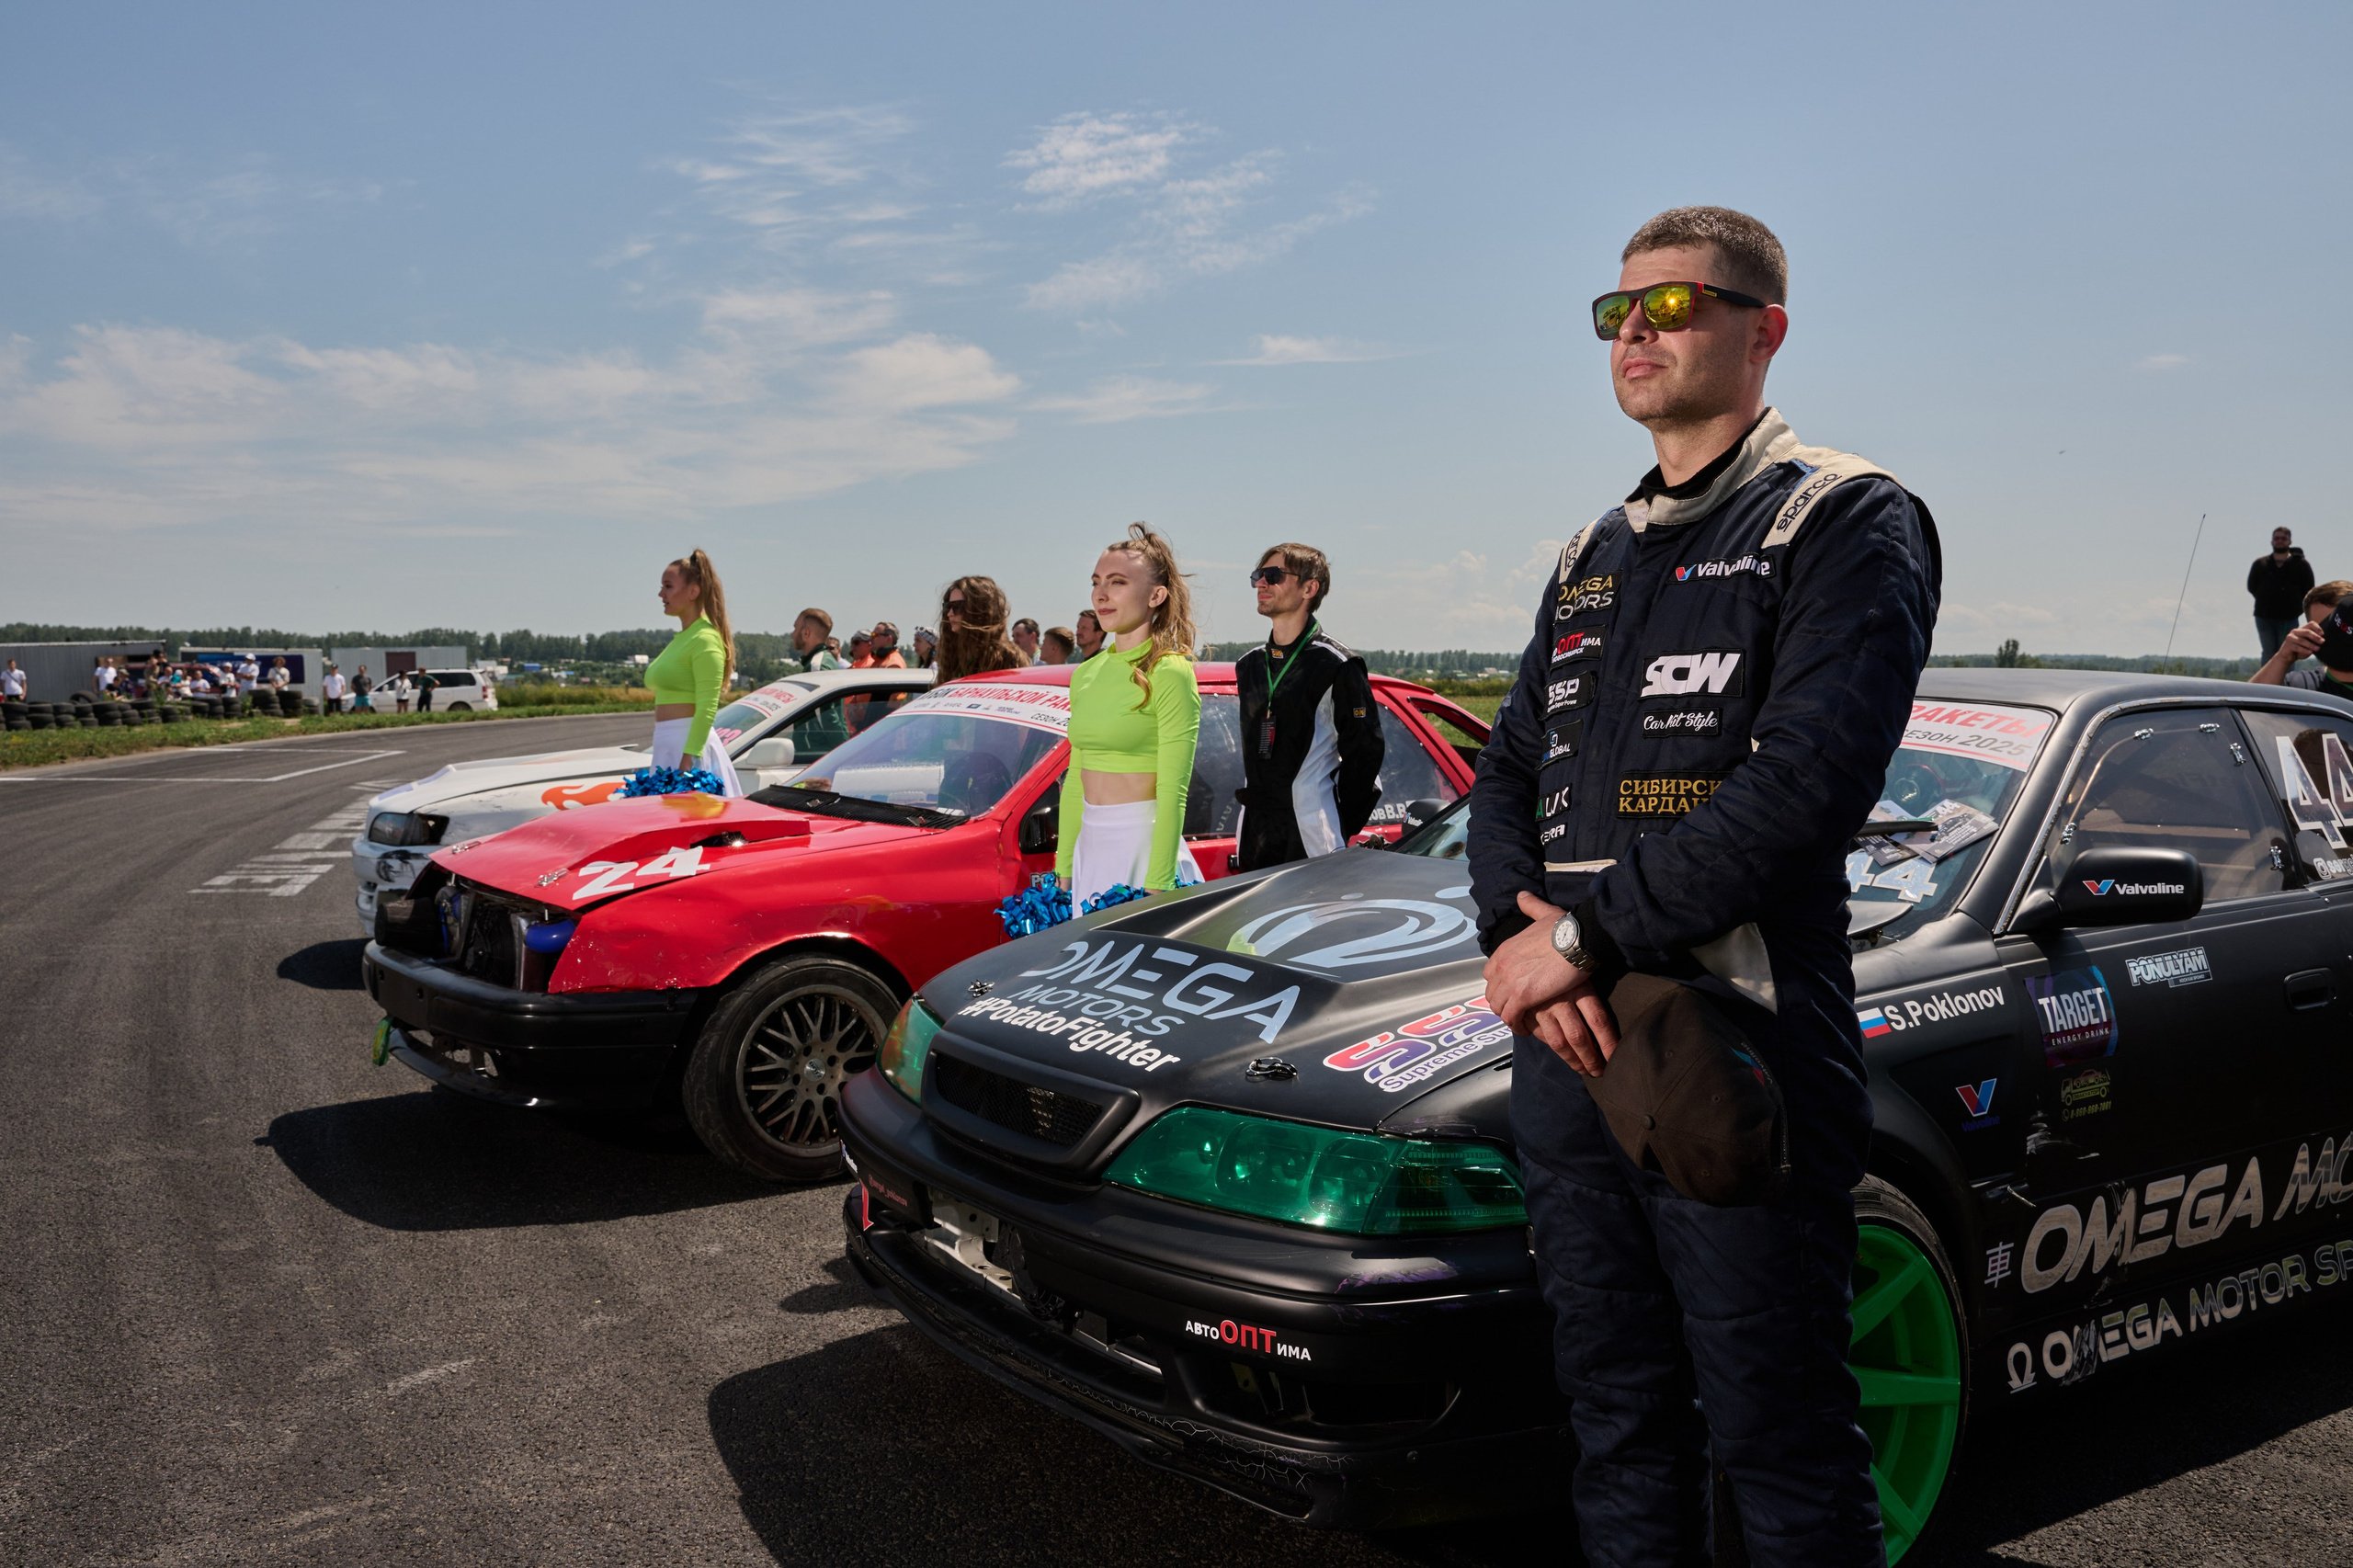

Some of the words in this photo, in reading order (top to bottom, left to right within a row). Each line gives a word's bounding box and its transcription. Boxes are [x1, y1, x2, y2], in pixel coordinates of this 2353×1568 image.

[1775, 472, 1843, 533] sparco
[1698, 555, 1770, 577] Valvoline
[1548, 678, 1579, 706] SSP
[1641, 652, 1741, 697] SCW
[948, 687, 1051, 705] БАРНАУЛЬСКОЙ
[1039, 695, 1071, 711] РАК
[1030, 712, 1060, 723] СЕЗОН
[1643, 715, 1665, 730] Car
[1685, 710, 1718, 732] Style
[1911, 705, 2051, 738] РАКЕТЫ
[1904, 729, 1959, 744] ЕЗОН
[1957, 734, 2033, 756] 2025
[2275, 733, 2353, 849] 44
[572, 845, 710, 901] 24
[2115, 882, 2184, 895] Valvoline
[2127, 949, 2208, 984] PONULYAM
[1006, 983, 1186, 1036] MOTORS
[1884, 986, 2005, 1031] S.Poklonov
[2038, 986, 2107, 1033] TARGET
[957, 996, 1182, 1073] #PotatoFighter
[2051, 1032, 2082, 1046] ENERGY
[2085, 1028, 2110, 1039] DRINK
[1381, 1042, 1480, 1091] Supreme
[1961, 1116, 2000, 1132] Valvoline
[2021, 1156, 2264, 1294] OMEGA
[1984, 1241, 2015, 1289] 車
[2189, 1254, 2312, 1333] MOTOR
